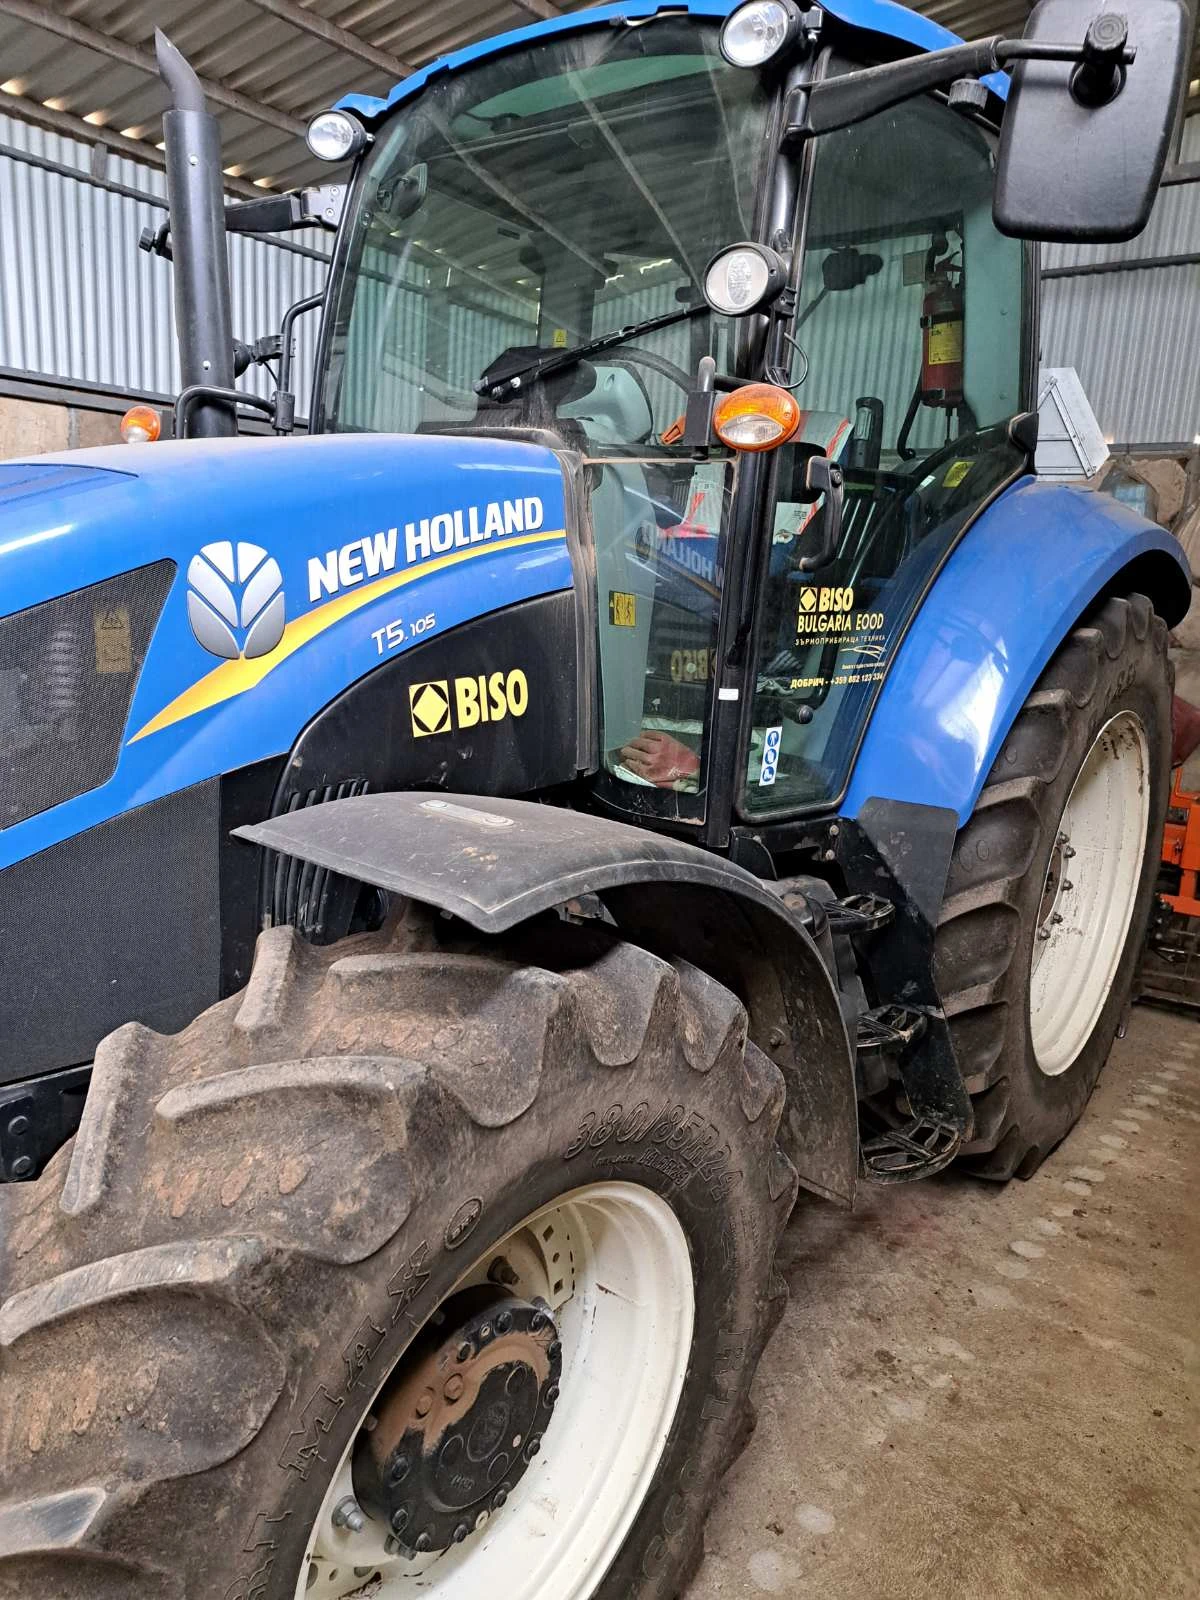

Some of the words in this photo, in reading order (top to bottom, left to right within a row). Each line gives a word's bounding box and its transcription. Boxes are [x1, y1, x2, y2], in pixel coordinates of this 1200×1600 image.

[307, 528, 398, 603] NEW
[405, 497, 543, 564] HOLLAND
[818, 587, 854, 612] BISO
[797, 614, 851, 632] BULGARIA
[855, 613, 884, 630] EOOD
[795, 637, 859, 646] ЗЪРНОПРИБИРАЩА
[861, 635, 886, 643] ТЕХНИКА
[790, 678, 825, 690] ДОБРИЧ
[831, 676, 848, 685] +359
[454, 669, 529, 729] BISO
[563, 1099, 744, 1202] 380/85R24
